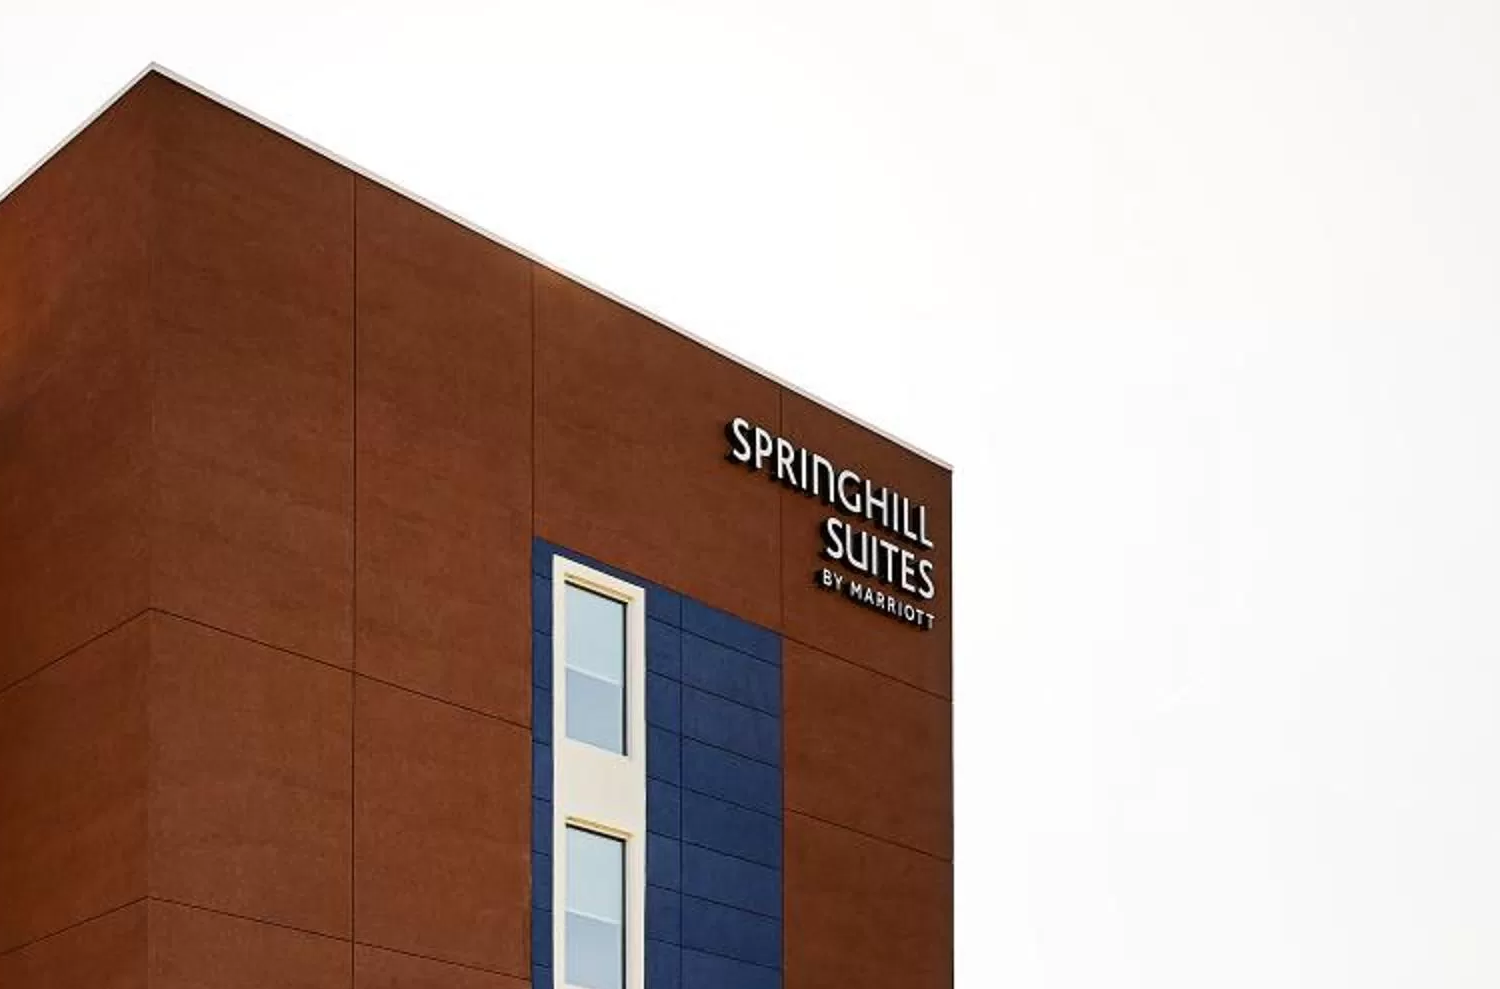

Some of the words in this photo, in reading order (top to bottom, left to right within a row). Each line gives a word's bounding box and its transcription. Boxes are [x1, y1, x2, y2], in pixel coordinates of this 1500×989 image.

[731, 417, 934, 549] SPRINGHILL
[822, 568, 843, 591] BY
[849, 581, 936, 629] MARRIOTT
[826, 517, 935, 599] SUITES
